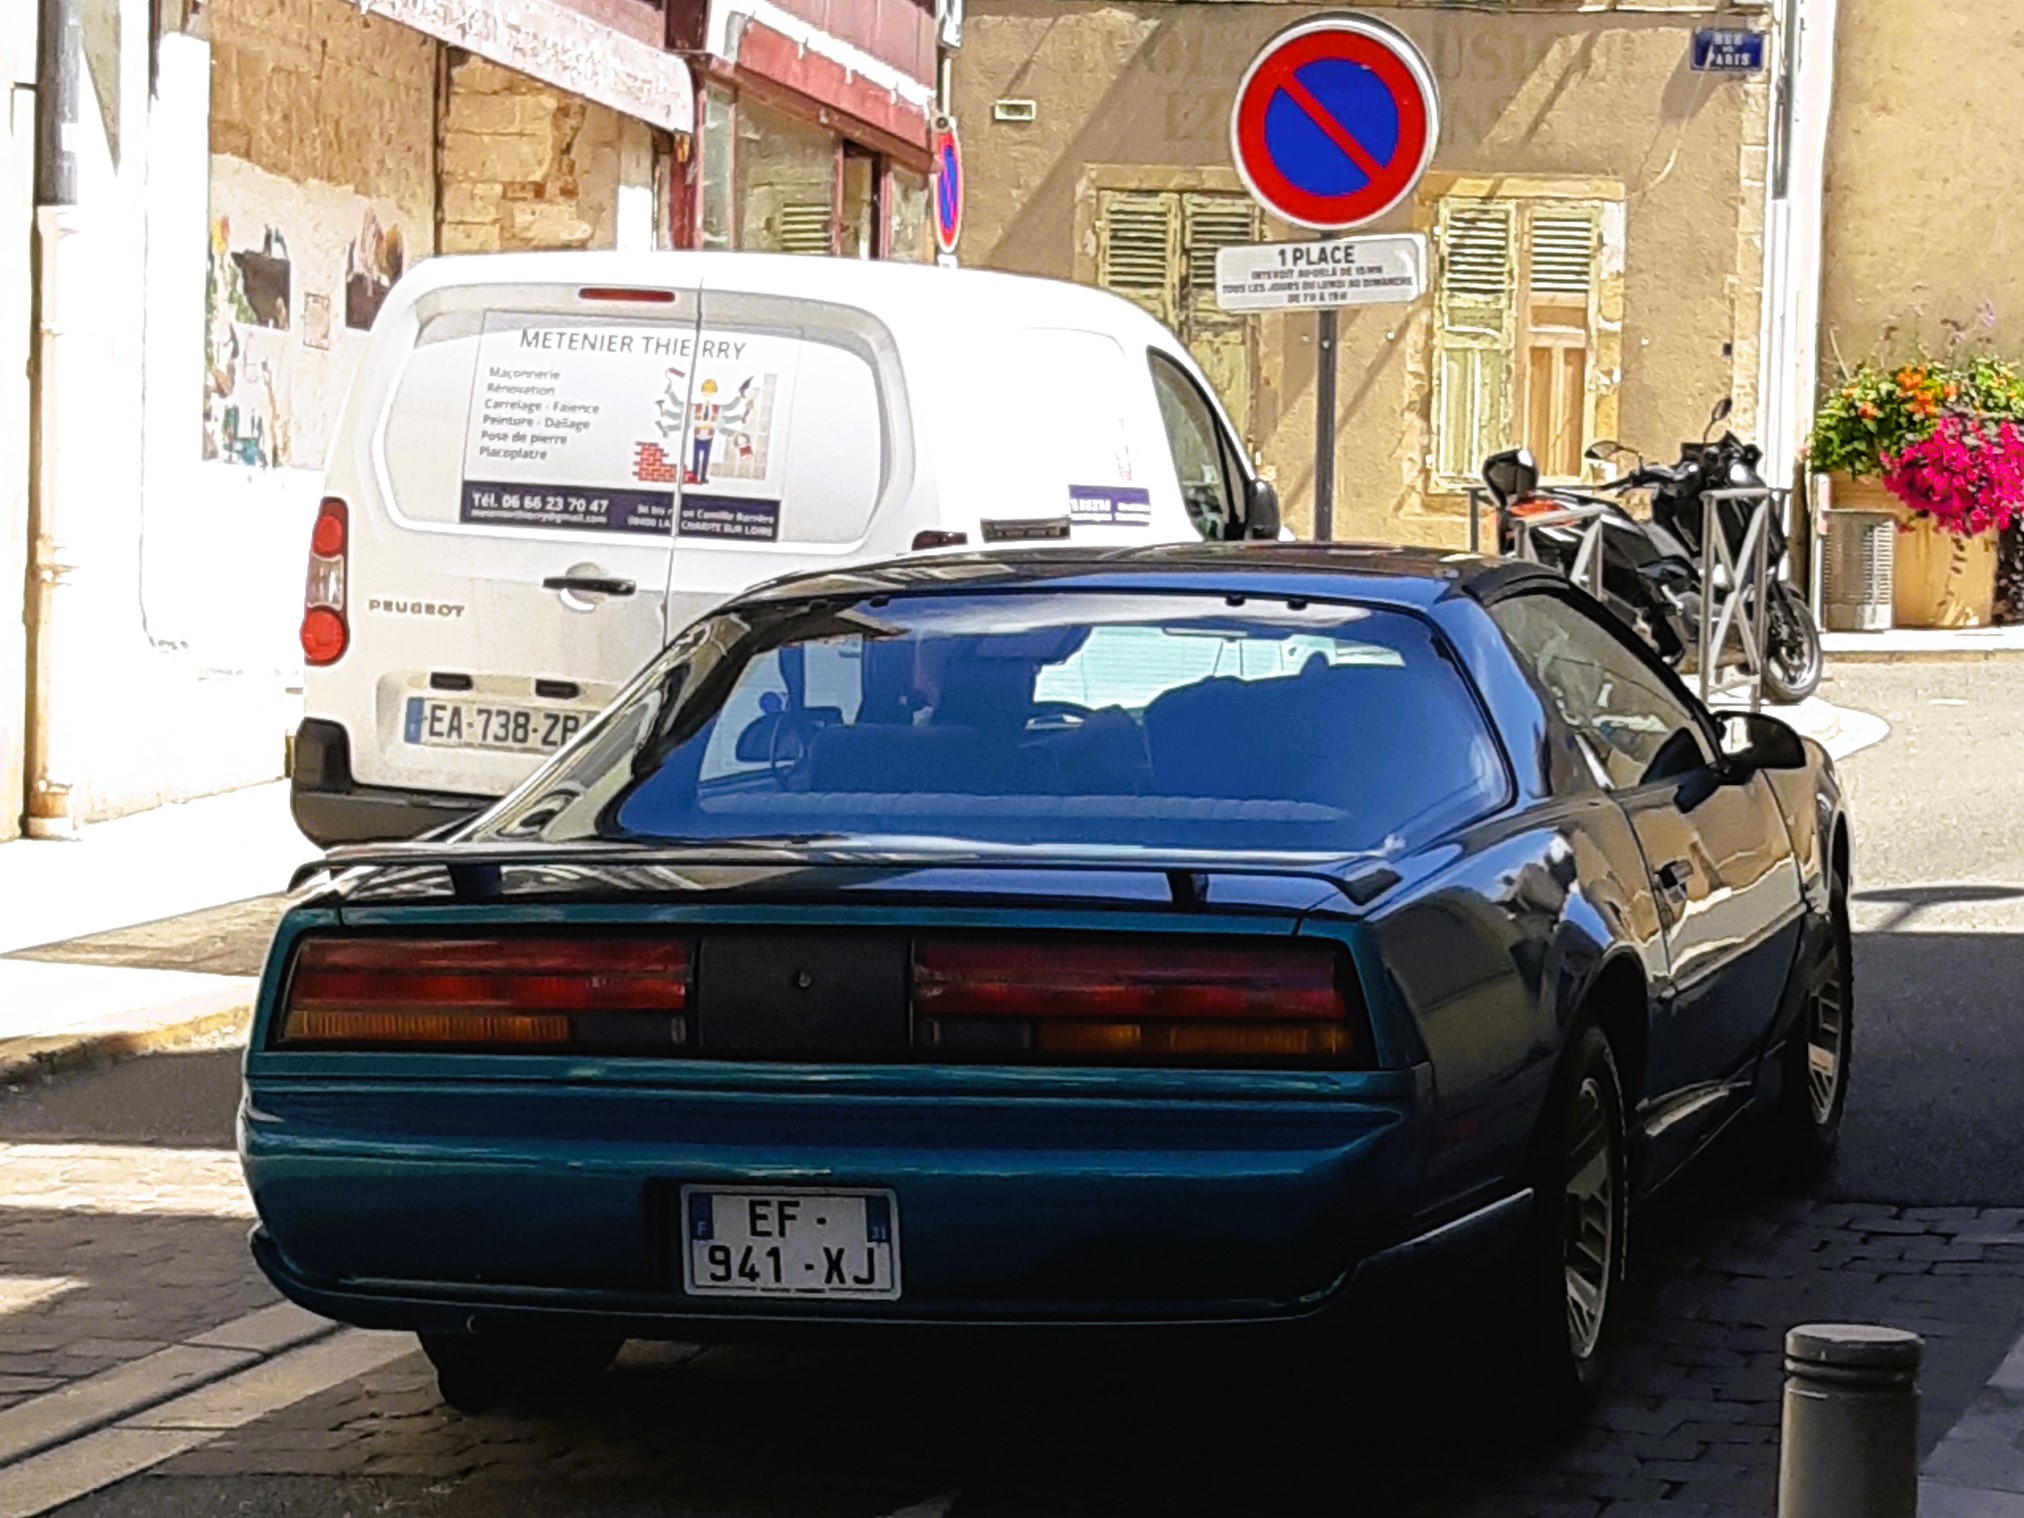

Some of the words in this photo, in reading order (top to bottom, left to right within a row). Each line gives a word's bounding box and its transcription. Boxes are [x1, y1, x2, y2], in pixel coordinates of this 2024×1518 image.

[1713, 32, 1743, 45] RUE
[1278, 248, 1286, 267] 1
[1292, 245, 1356, 267] PLACE
[1251, 269, 1293, 280] INTERDIT
[1340, 266, 1352, 277] DE
[1222, 284, 1246, 294] TOUS
[1248, 283, 1266, 293] LES
[1267, 281, 1300, 292] JOURS
[1302, 281, 1315, 291] DU
[1317, 279, 1346, 290] LUNDI
[1287, 293, 1301, 303] DE
[520, 328, 634, 353] METENIER
[641, 336, 747, 360] THIERRY
[489, 366, 560, 380] Maçonnerie
[487, 382, 556, 396] Rénovation
[484, 398, 543, 414] Carrelage
[483, 413, 534, 427] Peinture
[481, 429, 509, 441] Pose
[511, 431, 527, 443] de
[530, 433, 568, 446] pierre
[472, 492, 498, 508] Tél.
[502, 494, 521, 509] 06
[545, 497, 564, 511] 23
[567, 498, 587, 512] 70
[588, 499, 610, 513] 47
[367, 597, 466, 618] PEUGEOT
